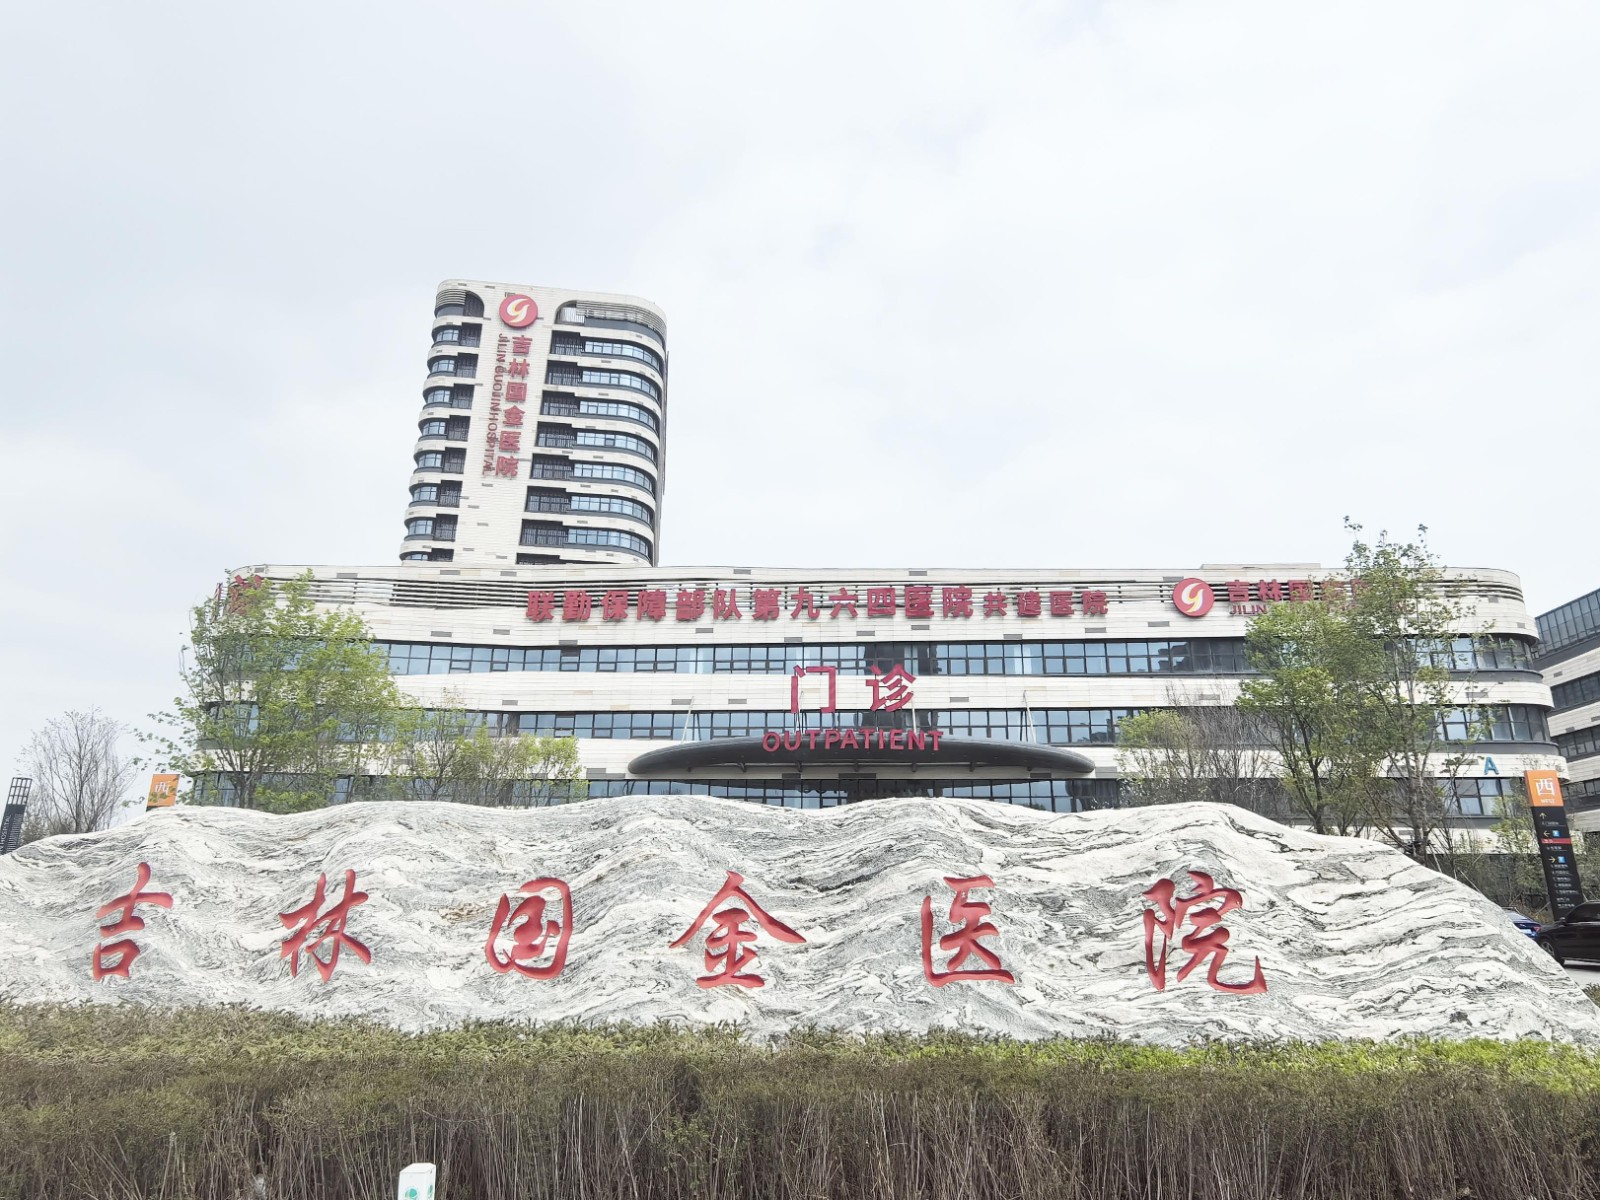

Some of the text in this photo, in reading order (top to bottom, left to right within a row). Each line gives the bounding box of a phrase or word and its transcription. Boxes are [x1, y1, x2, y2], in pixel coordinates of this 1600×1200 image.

[494, 334, 533, 476] 吉林国金医院
[791, 664, 916, 713] 门诊
[762, 728, 944, 752] OUTPATIENT
[1484, 757, 1499, 775] A
[1534, 778, 1555, 796] 西
[92, 861, 1268, 994] 吉林国金医院
